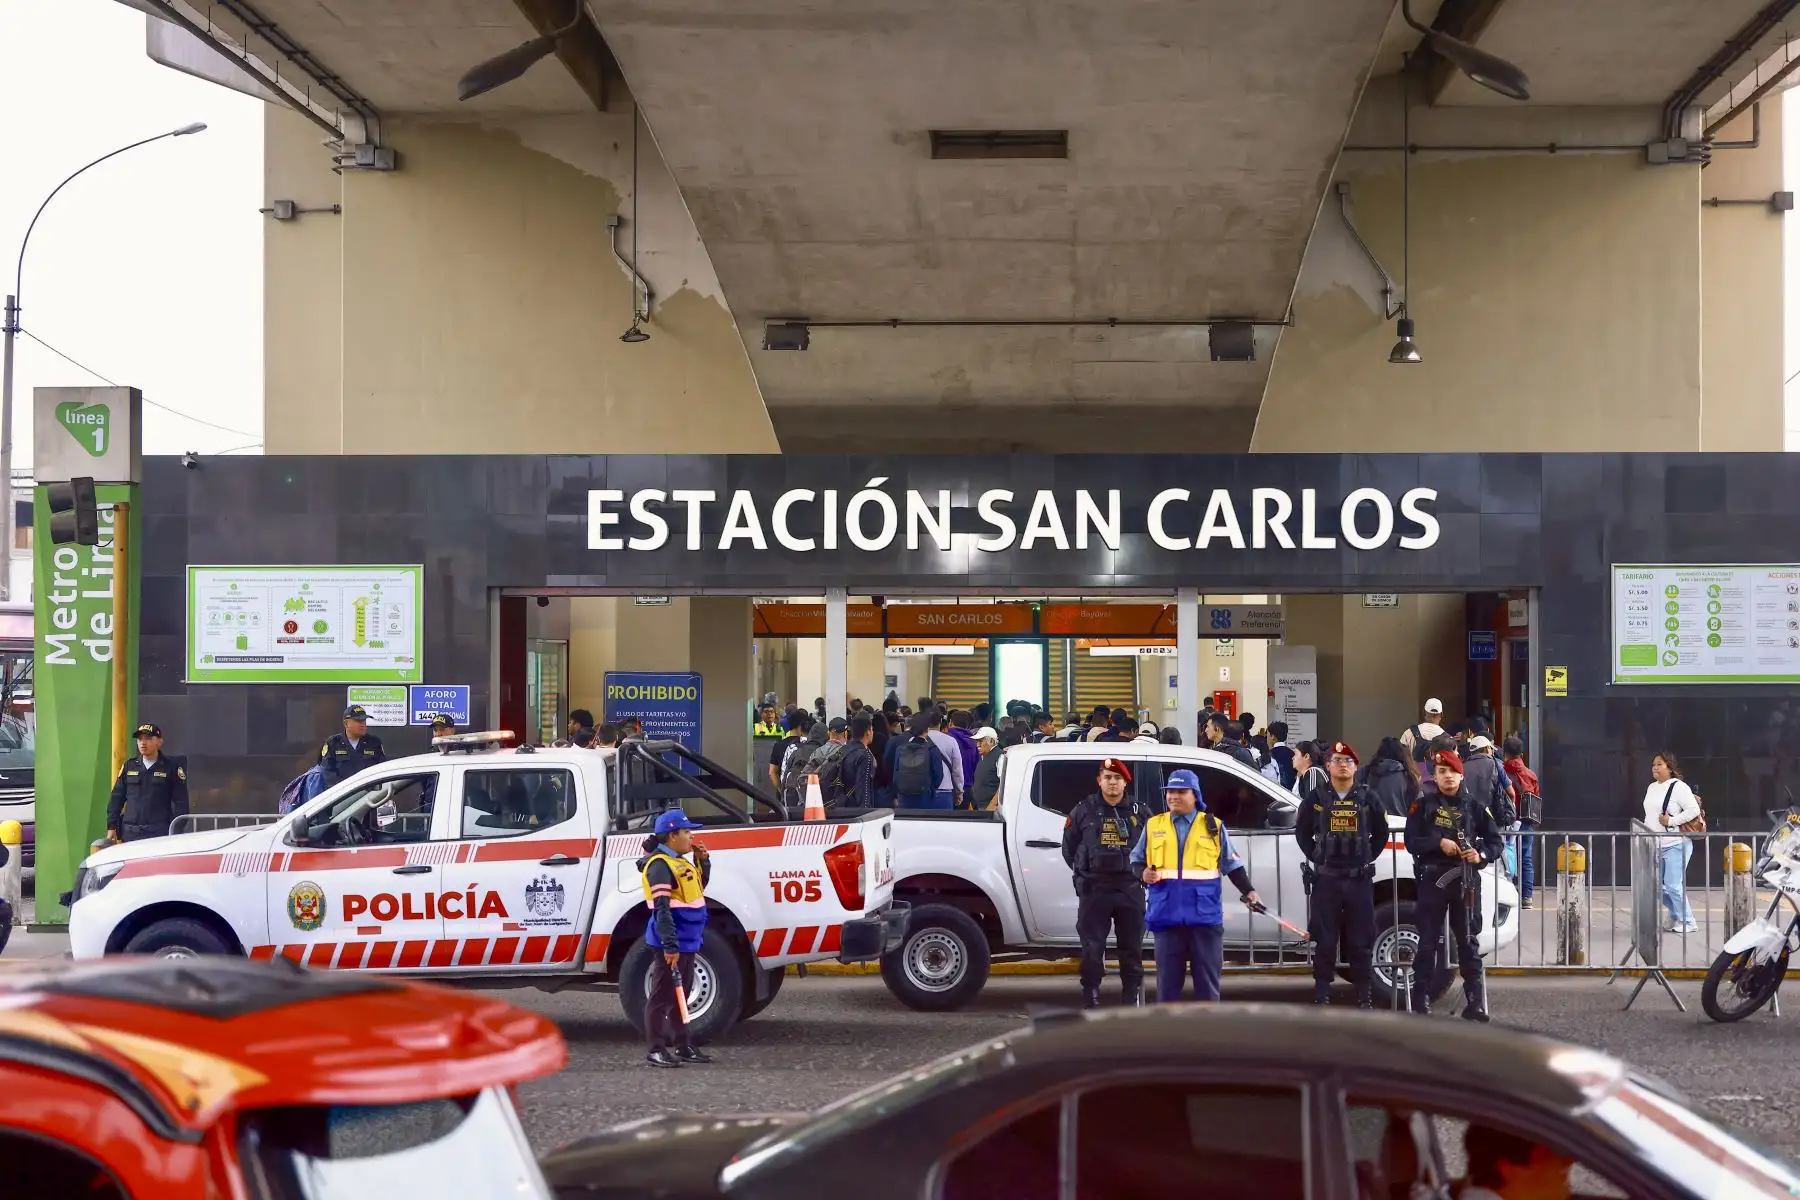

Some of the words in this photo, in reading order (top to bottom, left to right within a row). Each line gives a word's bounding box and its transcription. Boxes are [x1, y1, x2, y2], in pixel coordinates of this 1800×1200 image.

[92, 428, 104, 452] 1
[587, 476, 951, 552] ESTACIÓN
[977, 488, 1121, 552] SAN
[1147, 487, 1441, 551] CARLOS
[82, 502, 115, 598] Lima
[44, 546, 78, 665] Metro
[918, 614, 945, 625] SAN
[948, 614, 1003, 625] CARLOS
[81, 612, 114, 662] de
[424, 690, 457, 698] AFORO
[608, 685, 697, 700] PROHIBIDO
[418, 712, 437, 720] 1447
[426, 701, 455, 709] TOTAL
[769, 870, 805, 878] LLAMA
[808, 870, 822, 878] AL
[343, 883, 509, 922] POLICÍA
[770, 880, 822, 903] 105
